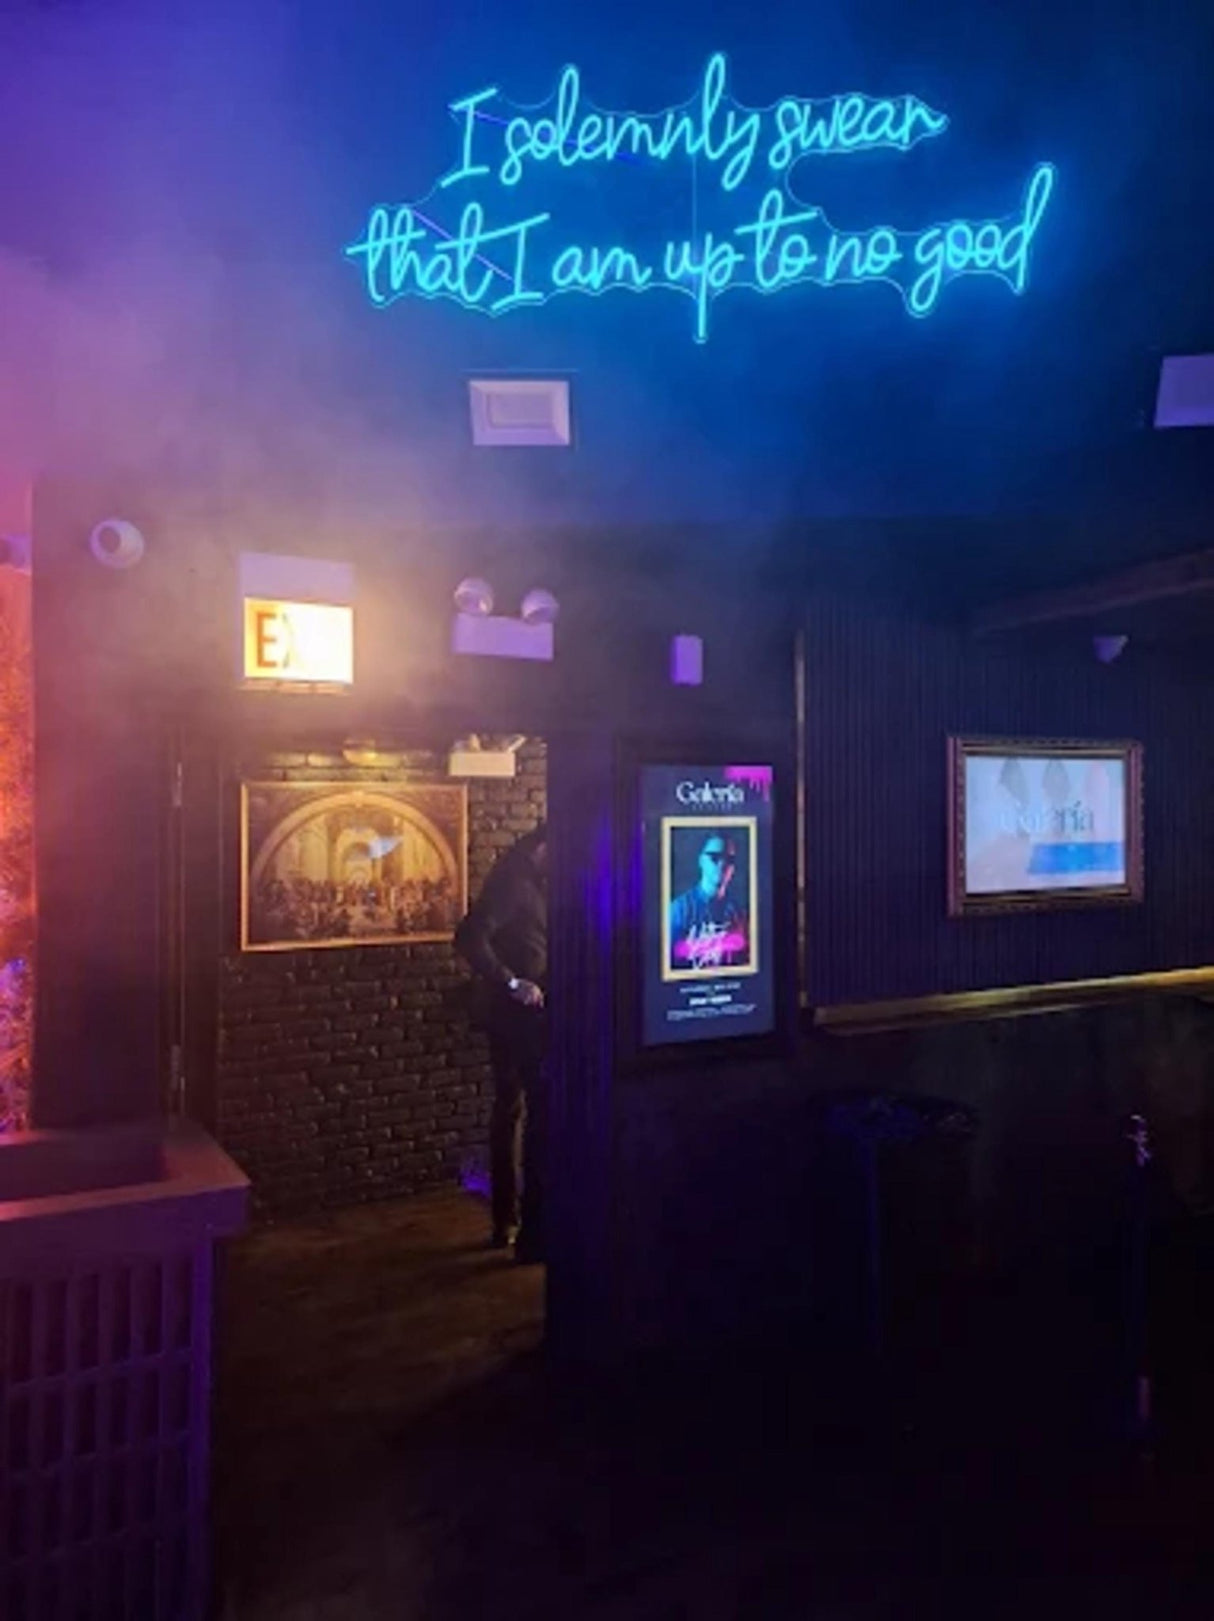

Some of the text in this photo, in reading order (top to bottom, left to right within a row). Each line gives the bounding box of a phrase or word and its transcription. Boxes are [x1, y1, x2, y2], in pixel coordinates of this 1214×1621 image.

[439, 53, 948, 190] I solemnly swear
[346, 163, 1057, 340] that I am up to no good
